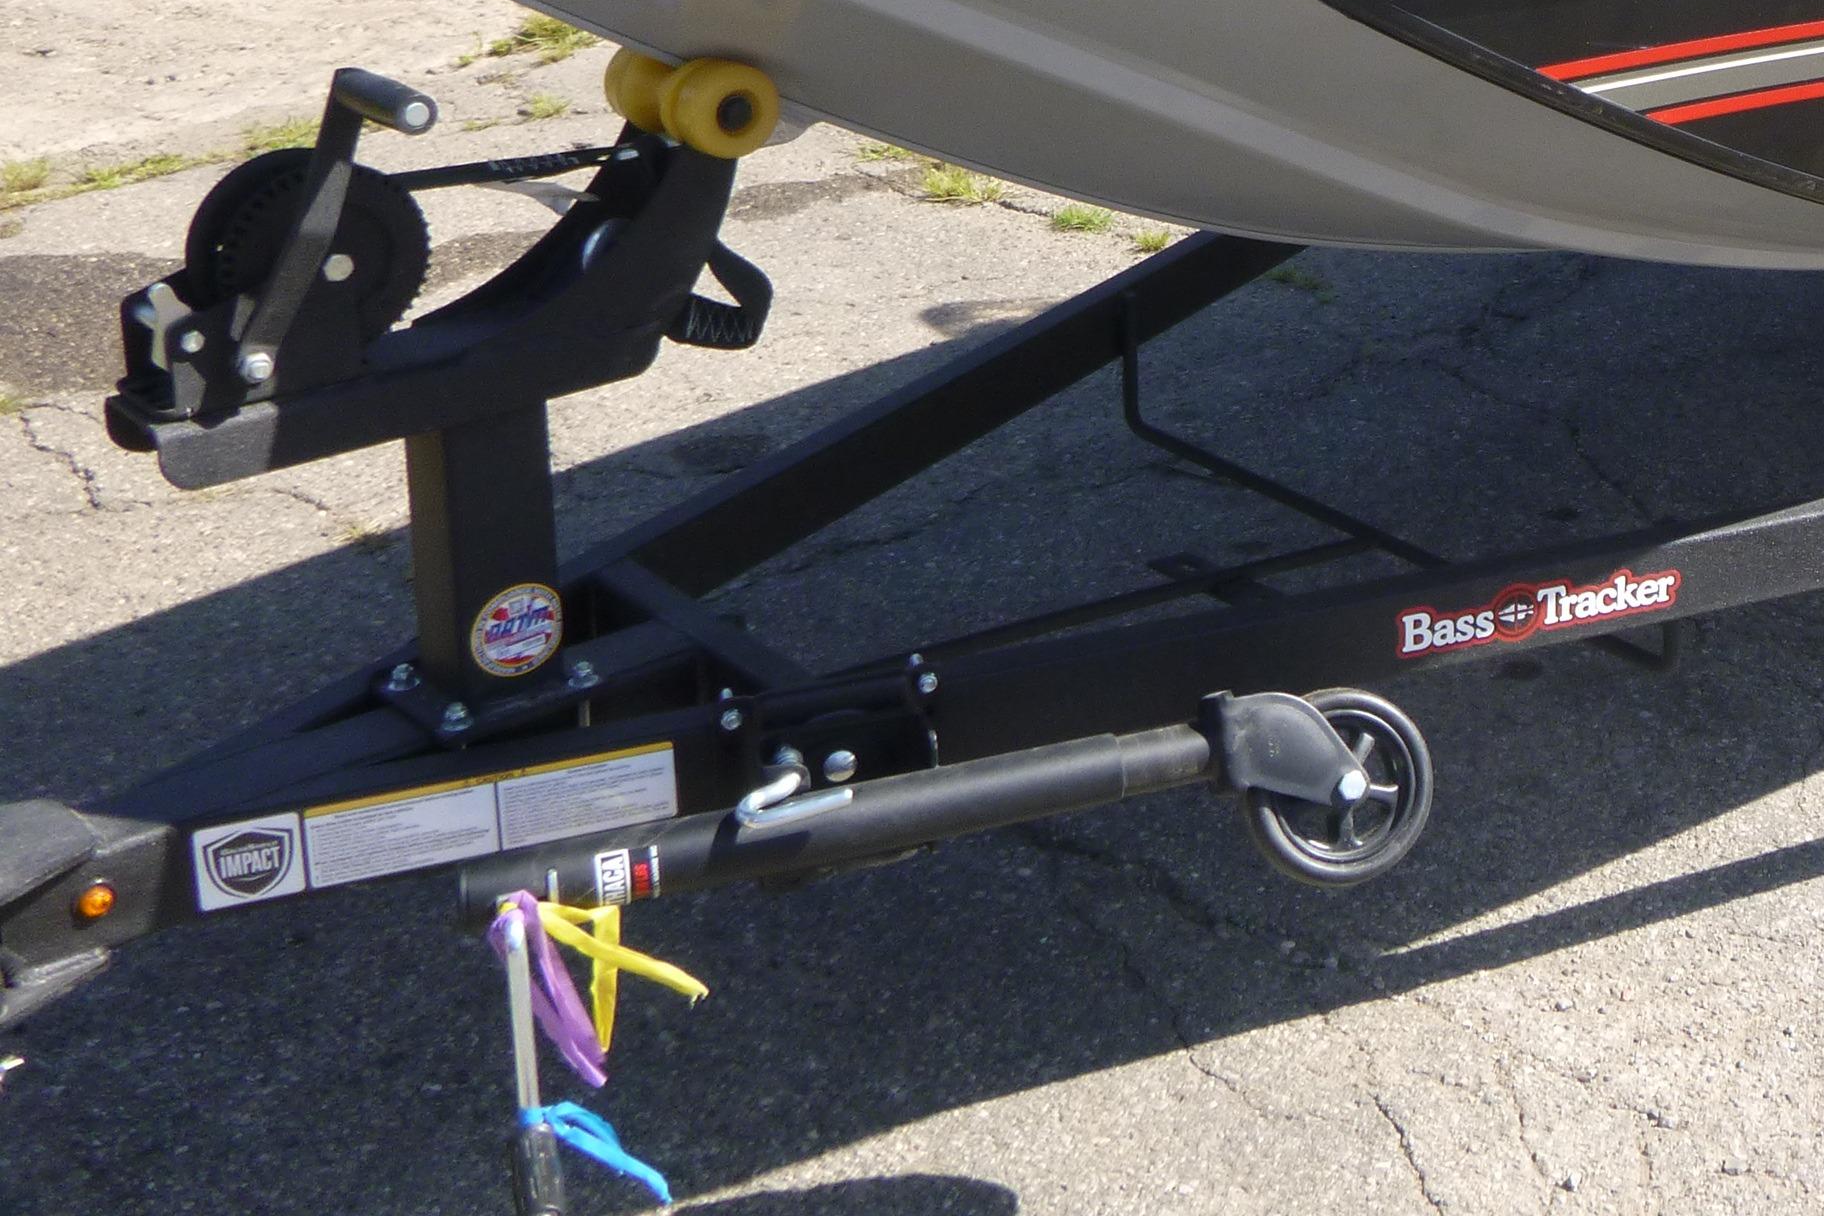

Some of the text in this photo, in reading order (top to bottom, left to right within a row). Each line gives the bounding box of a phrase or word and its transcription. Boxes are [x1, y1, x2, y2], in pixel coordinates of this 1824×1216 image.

[1402, 575, 1675, 653] Bass Tracker
[220, 846, 280, 879] IMPACT
